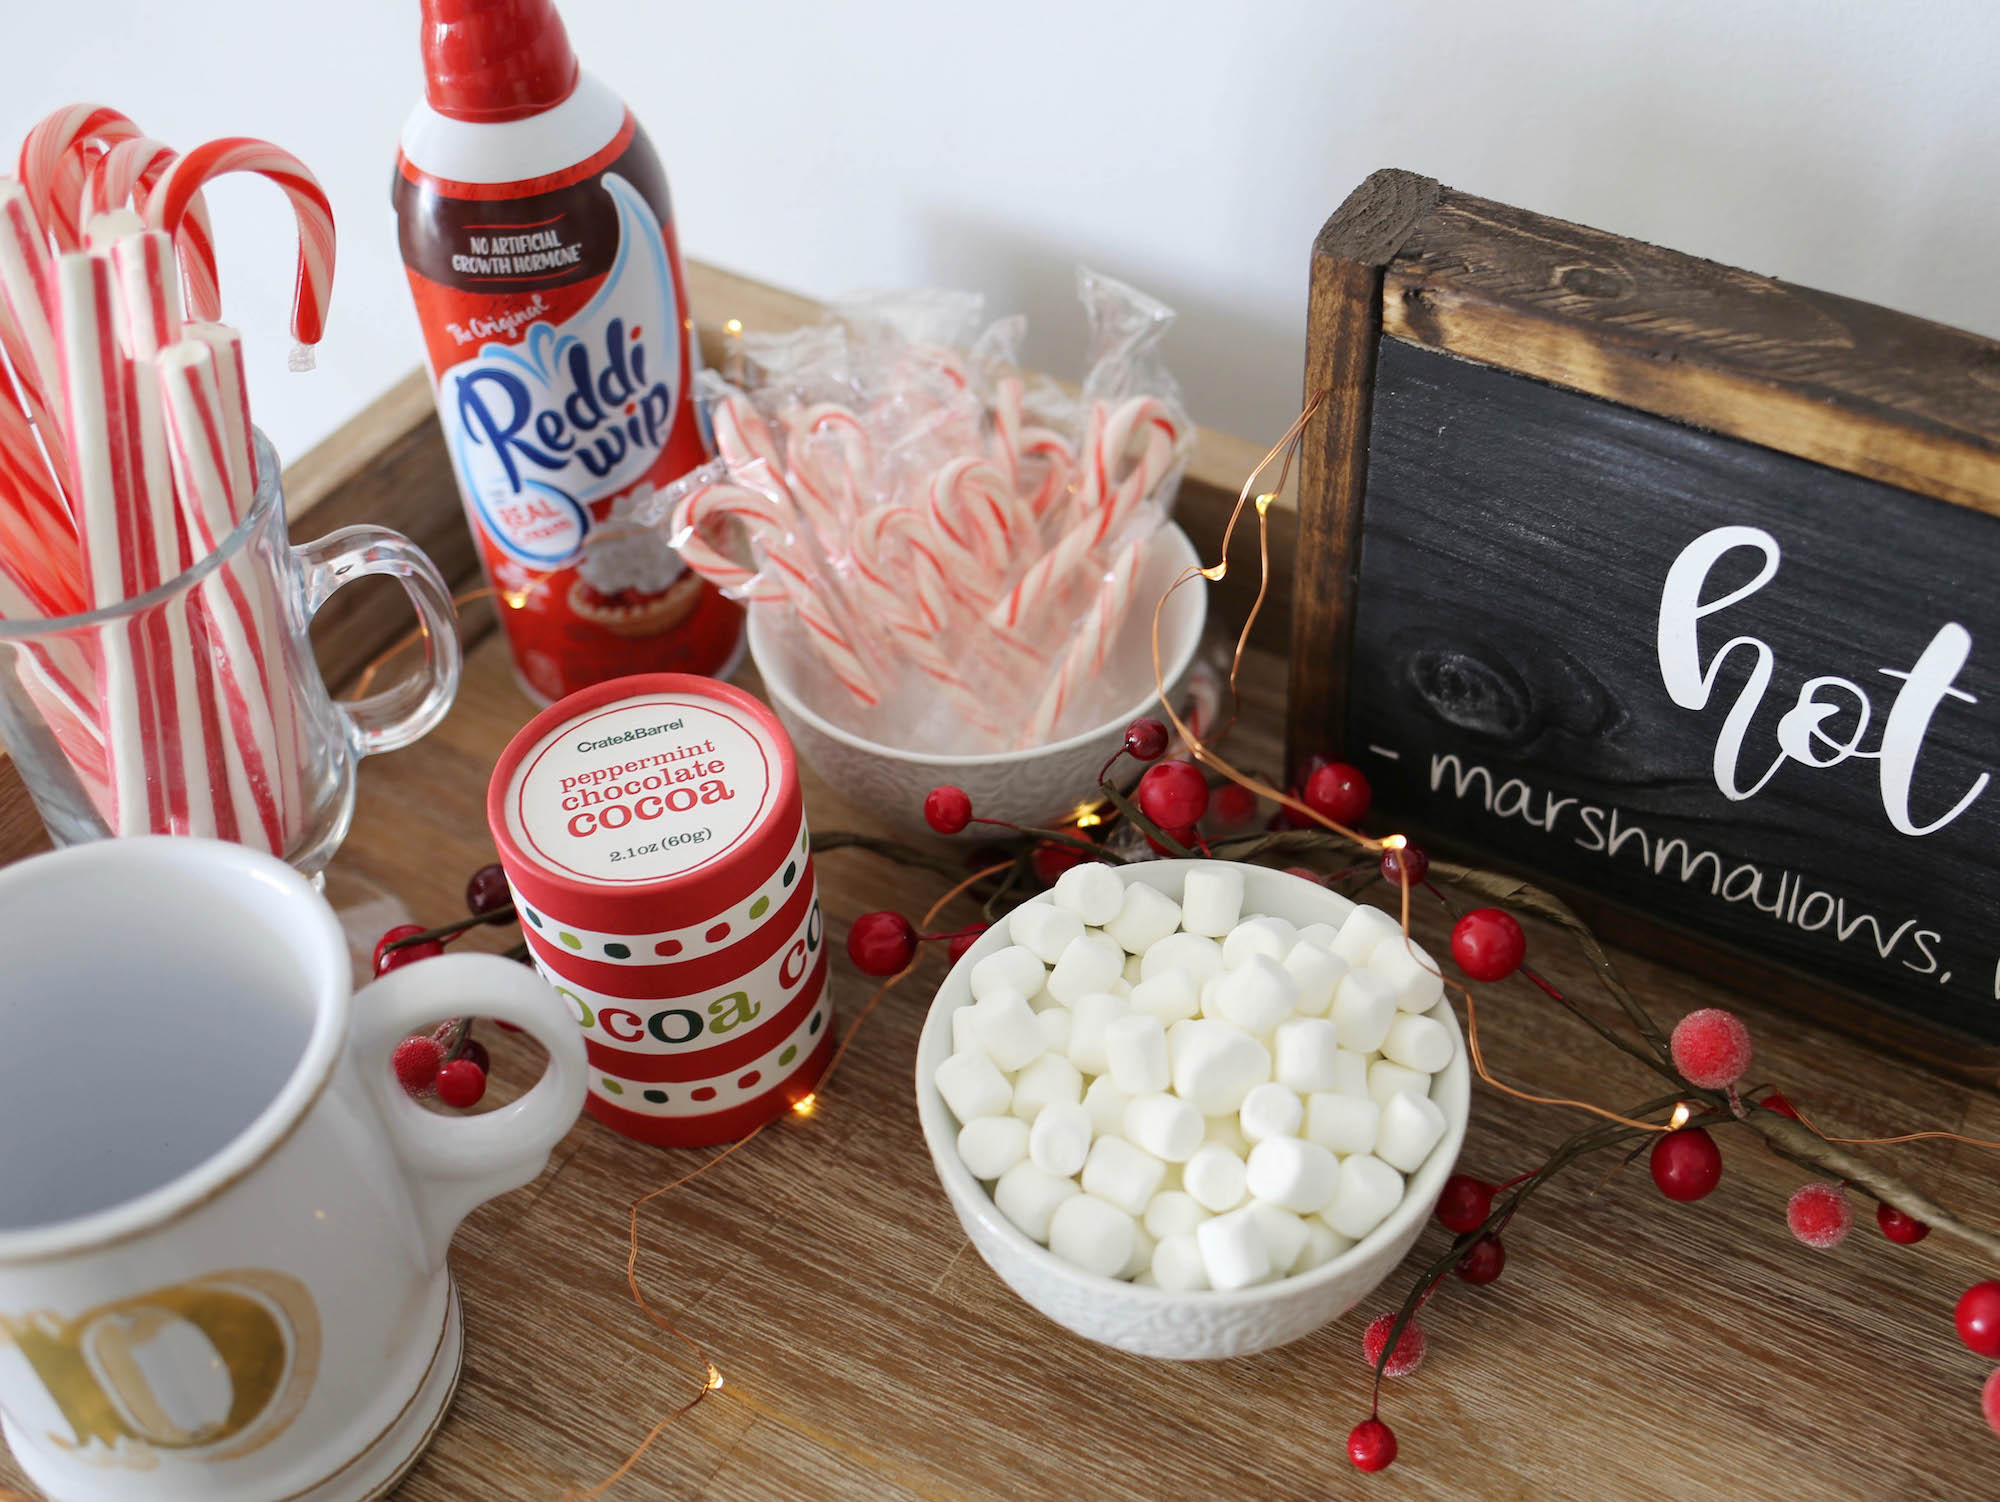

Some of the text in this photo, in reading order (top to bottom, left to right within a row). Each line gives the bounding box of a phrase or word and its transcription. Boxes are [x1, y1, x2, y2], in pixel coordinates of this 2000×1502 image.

[452, 254, 512, 274] GROWTH
[470, 229, 562, 255] NO ARTIFICIAL
[469, 294, 550, 339] Original
[455, 317, 646, 494] Reddi
[575, 382, 670, 477] wip
[1657, 525, 1990, 837] hot
[576, 718, 684, 753] Crate&Barrel
[559, 738, 716, 794] peppermint
[561, 759, 725, 811] chocolate
[567, 779, 735, 838] cocoa
[609, 827, 713, 863] 2.1oz (60g)
[530, 954, 761, 1043] ocoa
